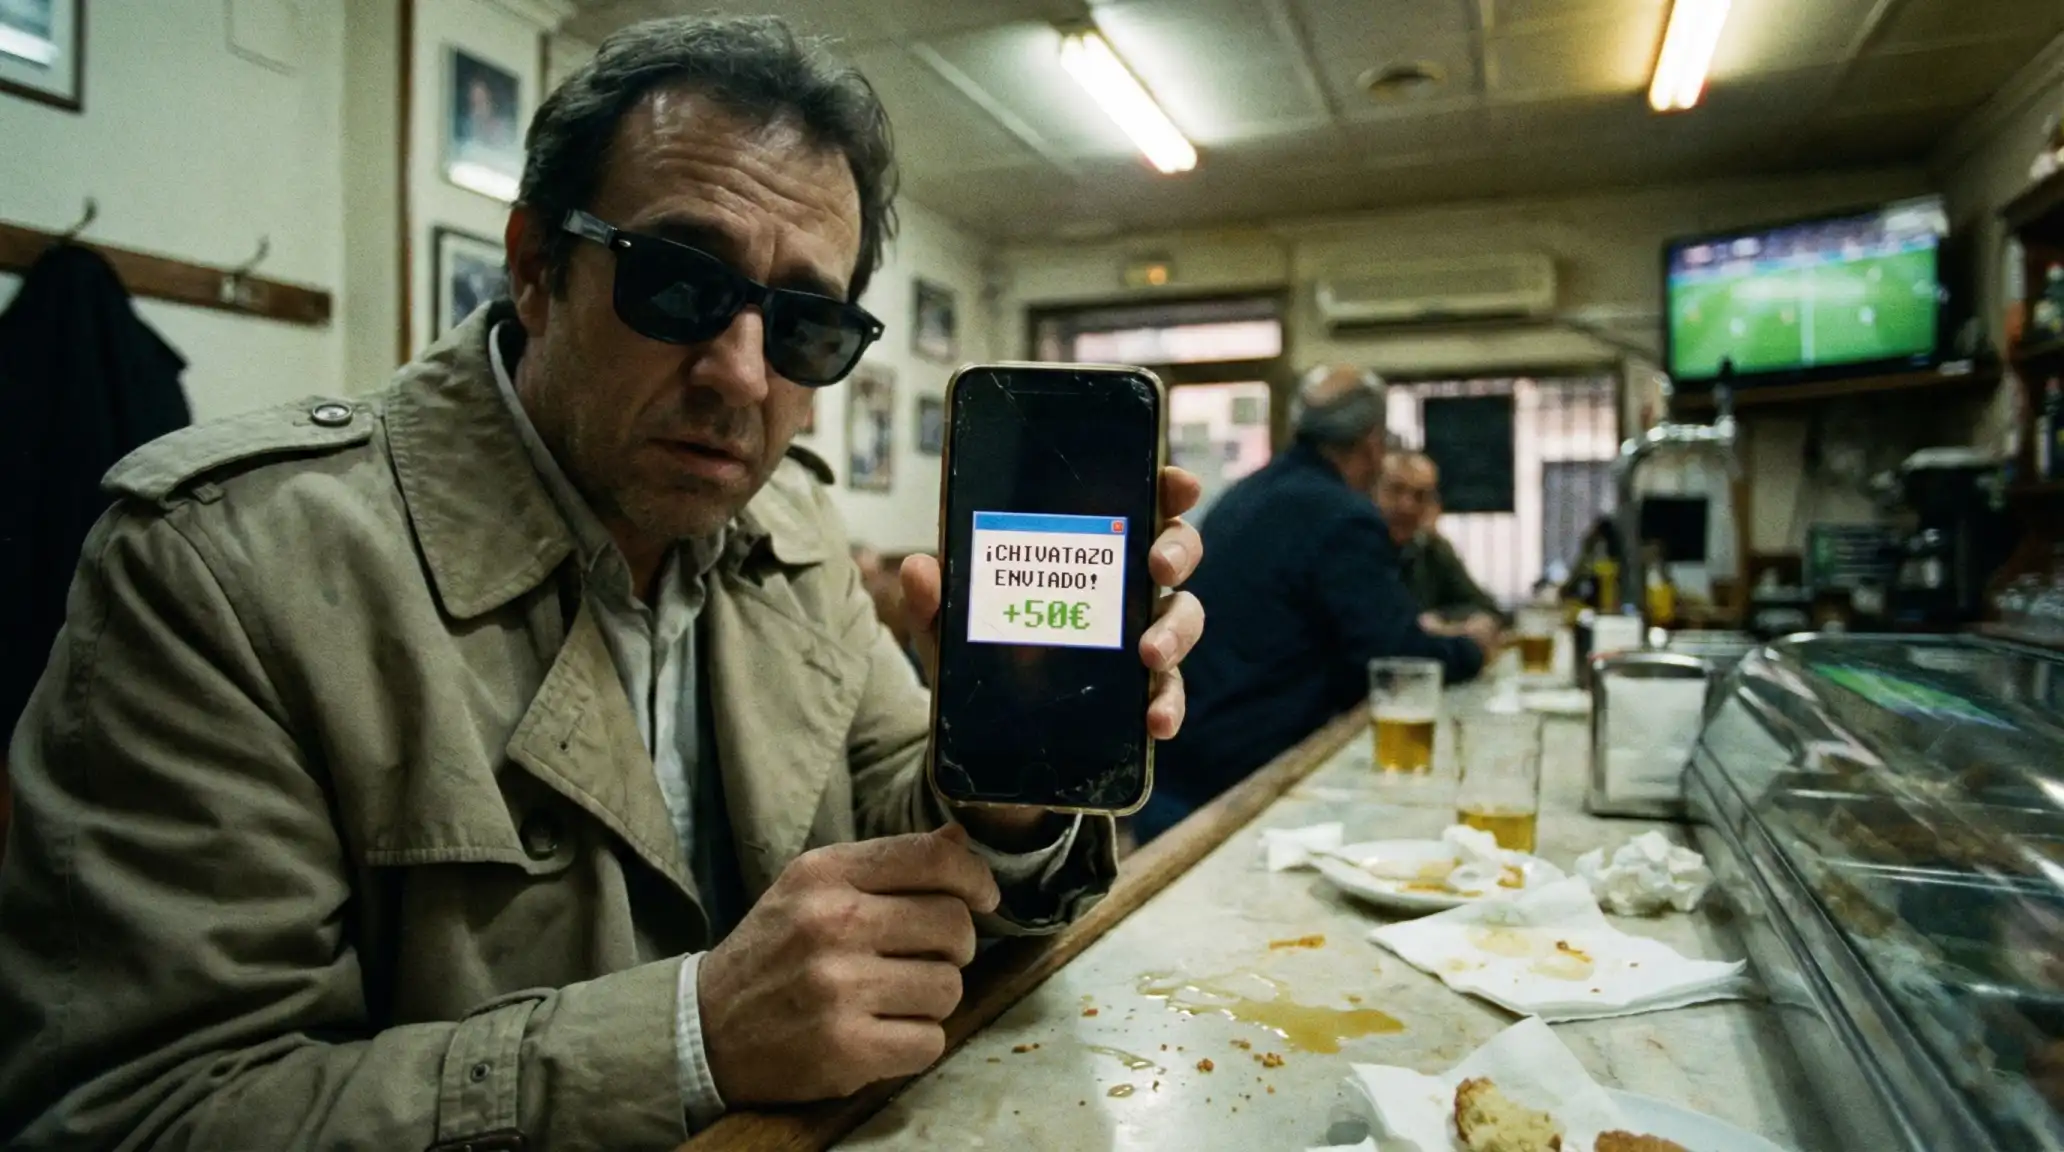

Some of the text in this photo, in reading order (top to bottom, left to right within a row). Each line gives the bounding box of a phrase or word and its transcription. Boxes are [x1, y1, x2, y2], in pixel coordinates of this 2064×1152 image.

[986, 544, 1114, 565] ¡CHIVATAZO
[994, 569, 1098, 589] ENVIADO!
[1002, 599, 1091, 630] +50€
